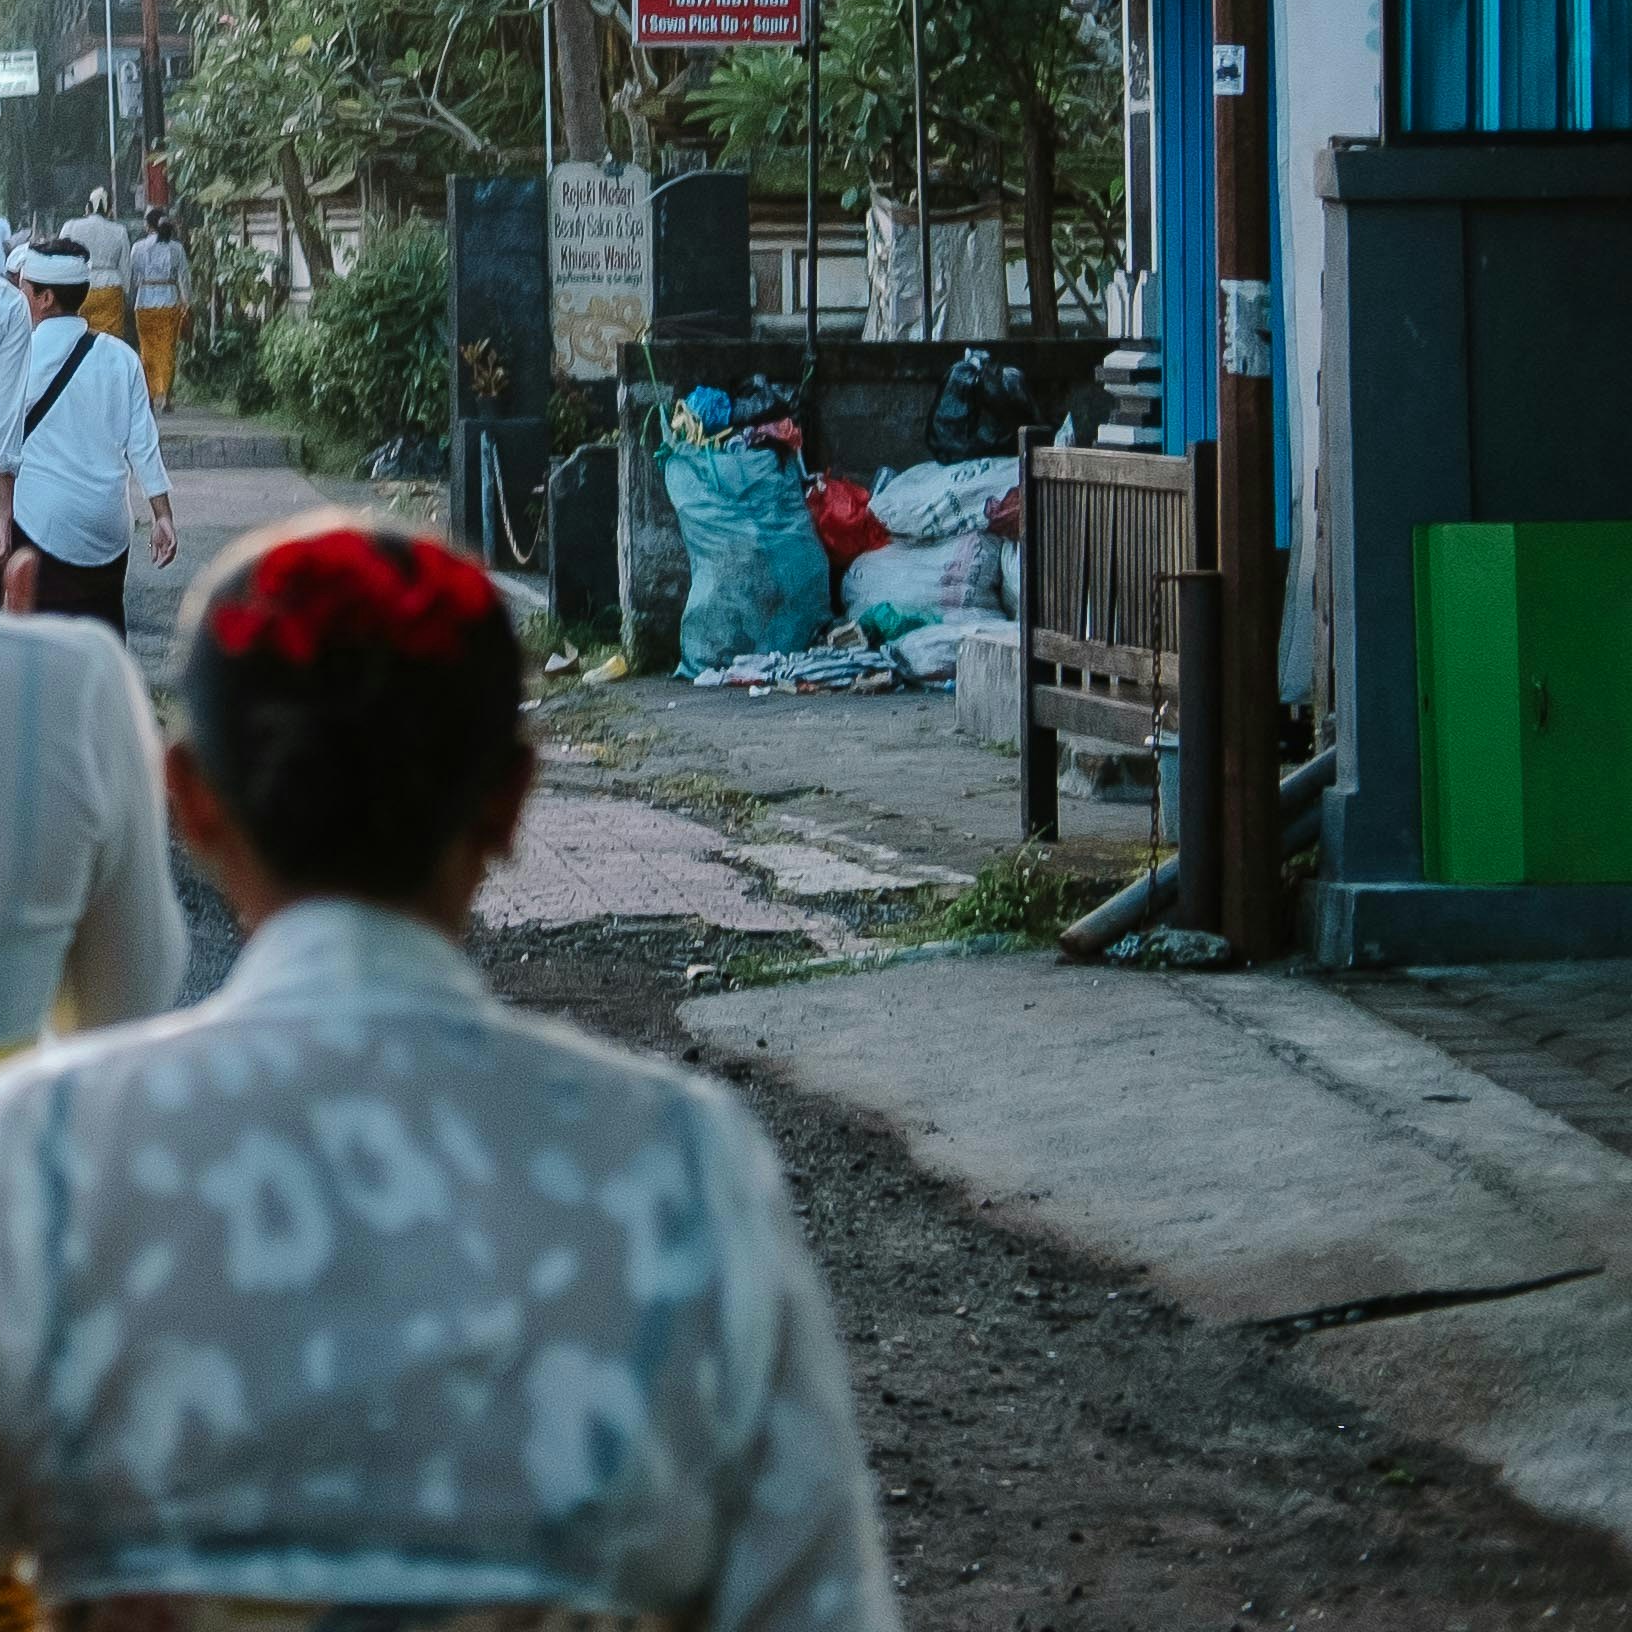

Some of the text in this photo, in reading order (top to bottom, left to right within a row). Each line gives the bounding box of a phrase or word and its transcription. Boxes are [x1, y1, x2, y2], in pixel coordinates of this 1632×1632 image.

[554, 212, 586, 245] Beauty
[587, 212, 614, 238] Salon
[624, 212, 644, 245] Spa
[560, 245, 642, 271] Khusus Wanita
